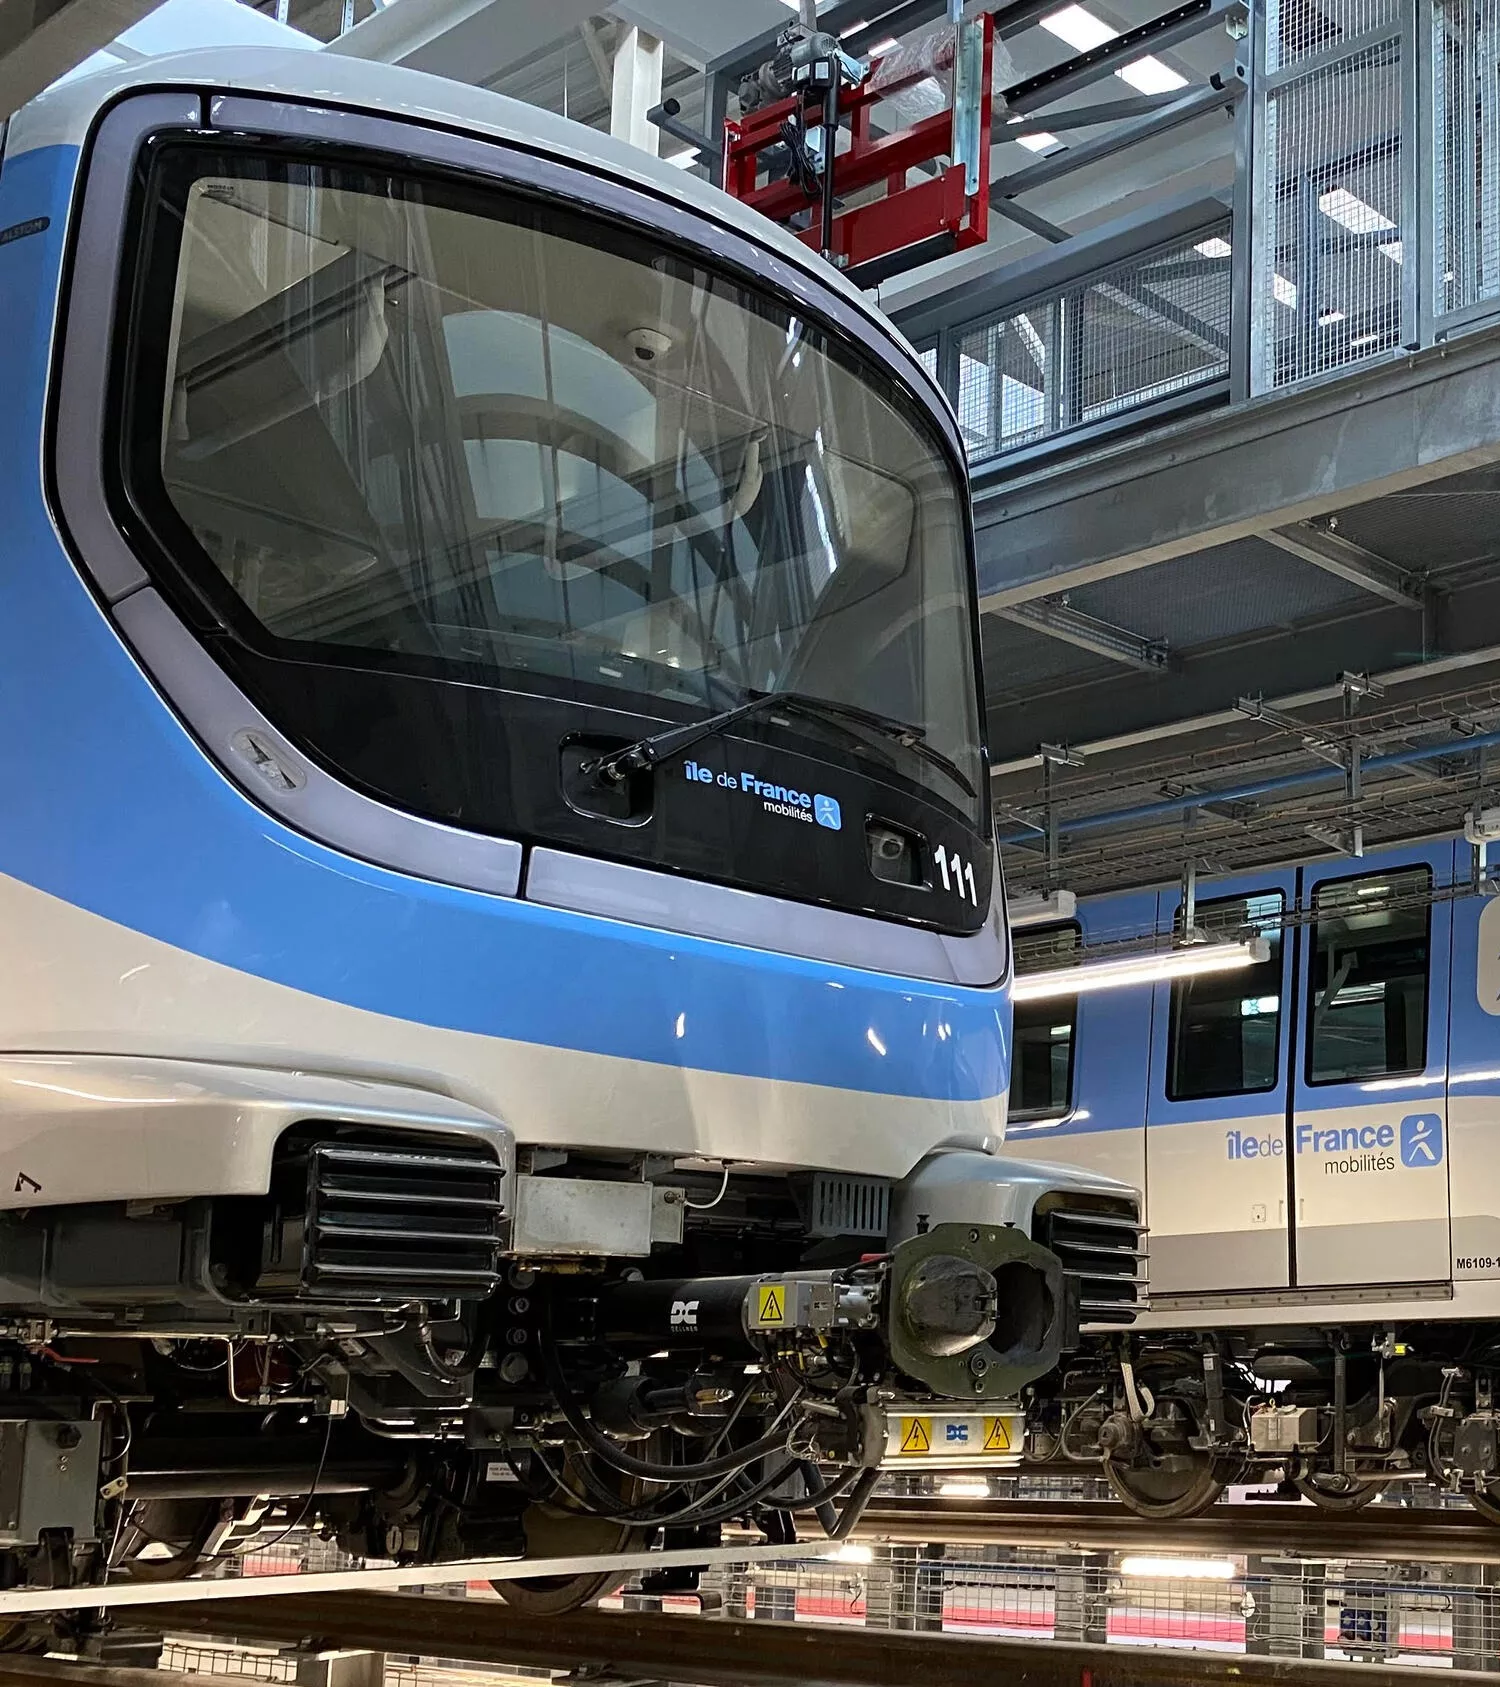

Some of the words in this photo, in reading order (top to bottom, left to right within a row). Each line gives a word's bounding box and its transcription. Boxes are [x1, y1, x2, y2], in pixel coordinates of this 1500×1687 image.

[683, 760, 713, 784] île
[716, 771, 738, 789] de
[741, 772, 812, 809] France
[763, 801, 813, 823] mobilités
[934, 844, 978, 908] 111
[1226, 1128, 1258, 1160] île
[1259, 1133, 1284, 1157] de
[1296, 1124, 1395, 1154] France
[1324, 1152, 1395, 1175] mobilités
[1456, 1257, 1500, 1269] M6109-1
